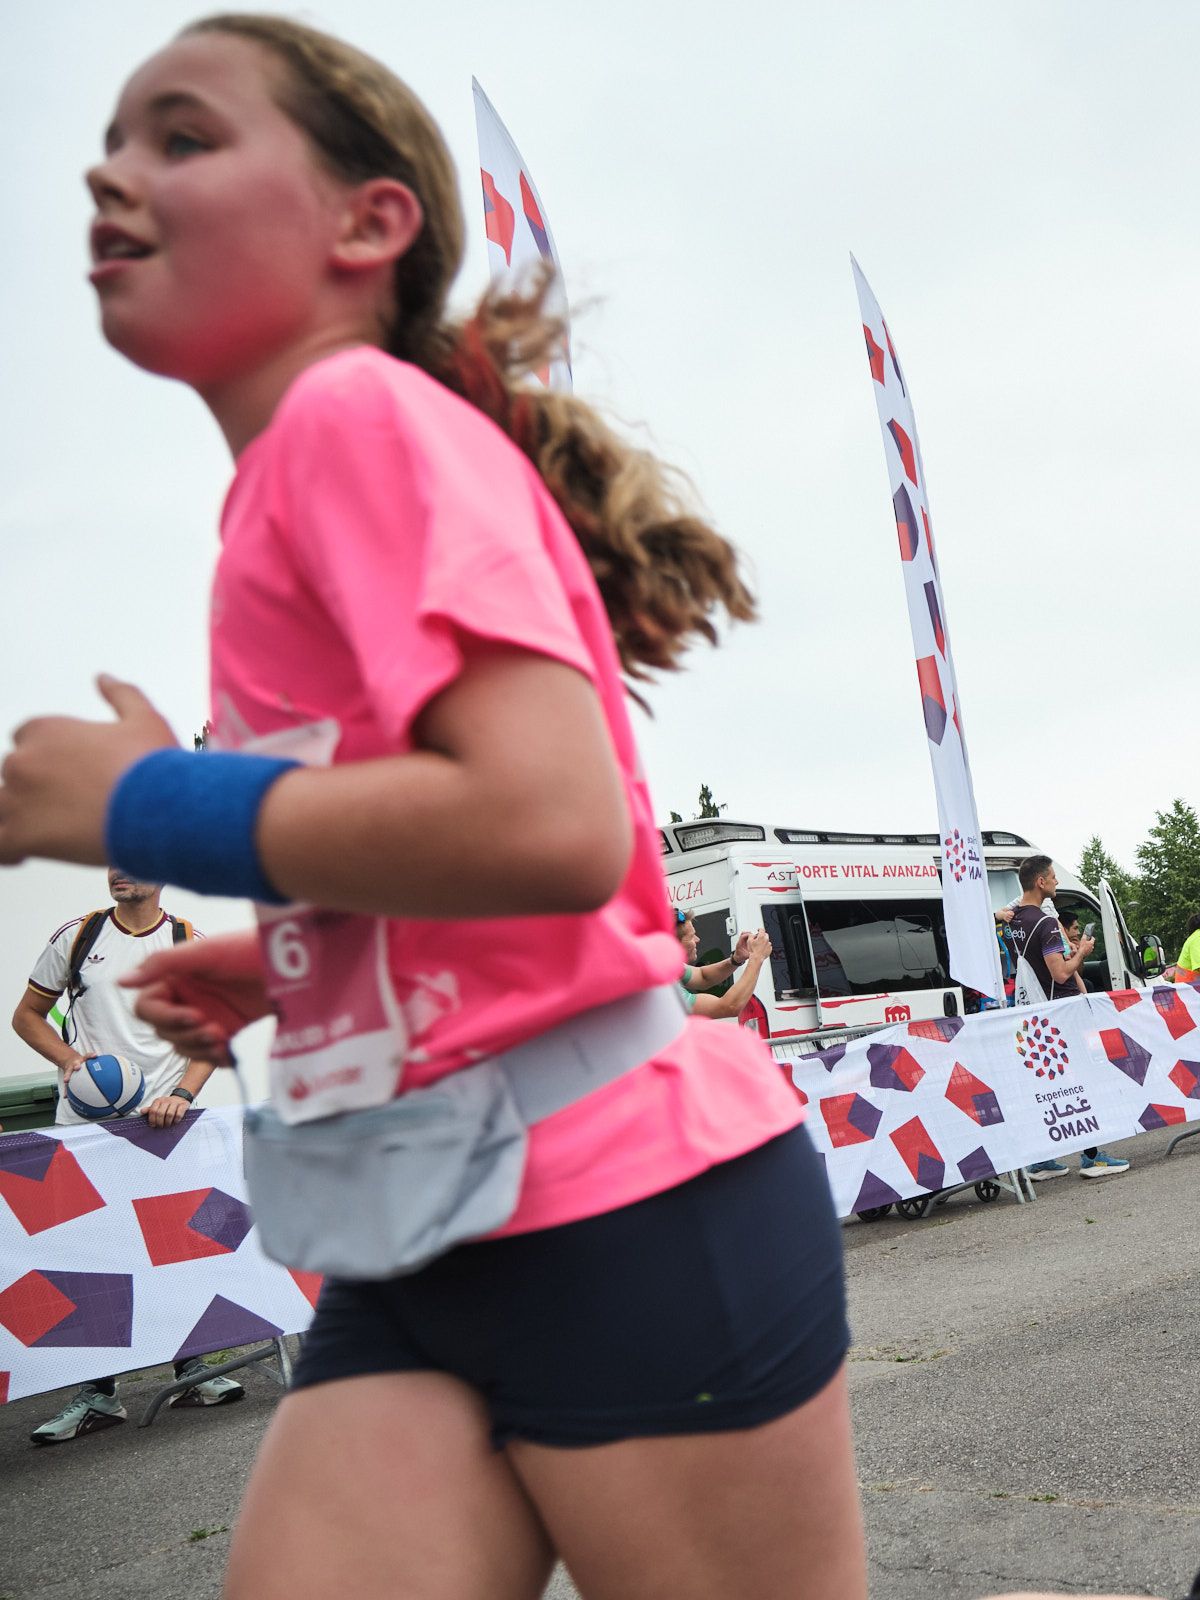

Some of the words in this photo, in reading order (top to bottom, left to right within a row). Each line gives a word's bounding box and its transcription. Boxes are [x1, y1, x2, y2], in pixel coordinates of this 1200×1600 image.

[841, 865, 878, 878] VITAL
[1035, 1085, 1084, 1104] Experience
[1048, 1115, 1100, 1142] OMAN
